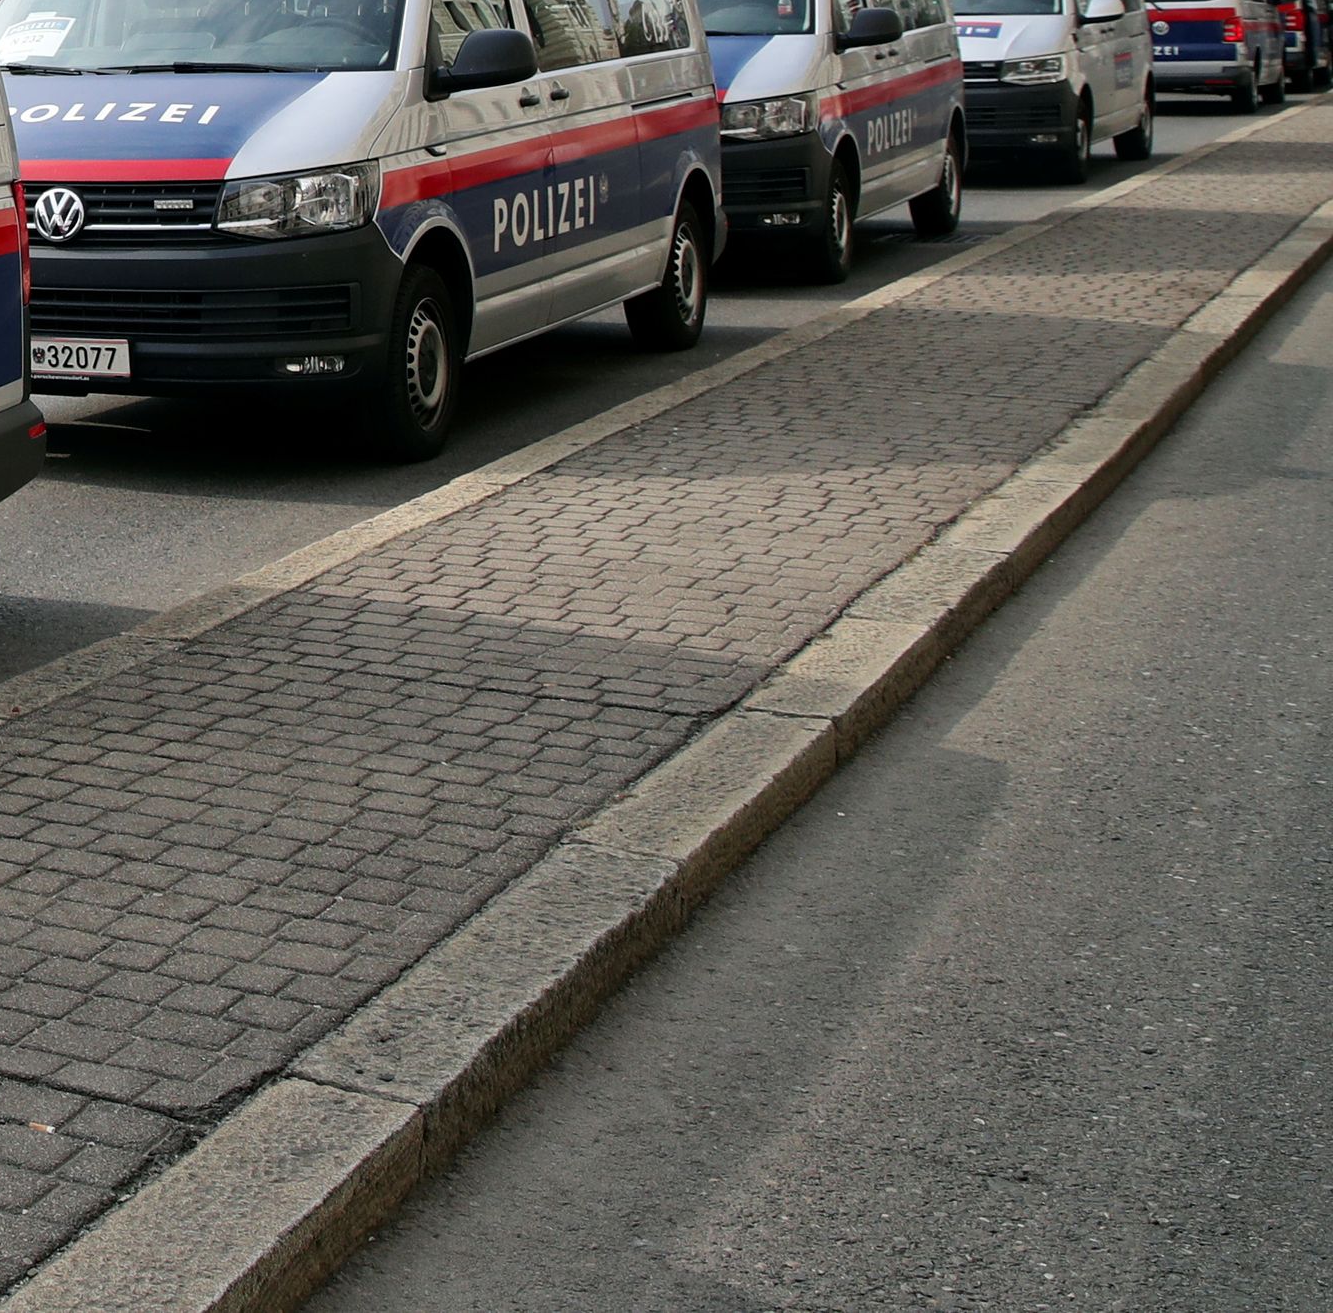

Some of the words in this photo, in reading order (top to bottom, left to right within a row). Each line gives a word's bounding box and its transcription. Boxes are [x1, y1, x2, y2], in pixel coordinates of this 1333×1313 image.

[867, 108, 912, 156] POLIZEI
[493, 175, 595, 253] POLIZEI
[46, 345, 118, 370] 32077
